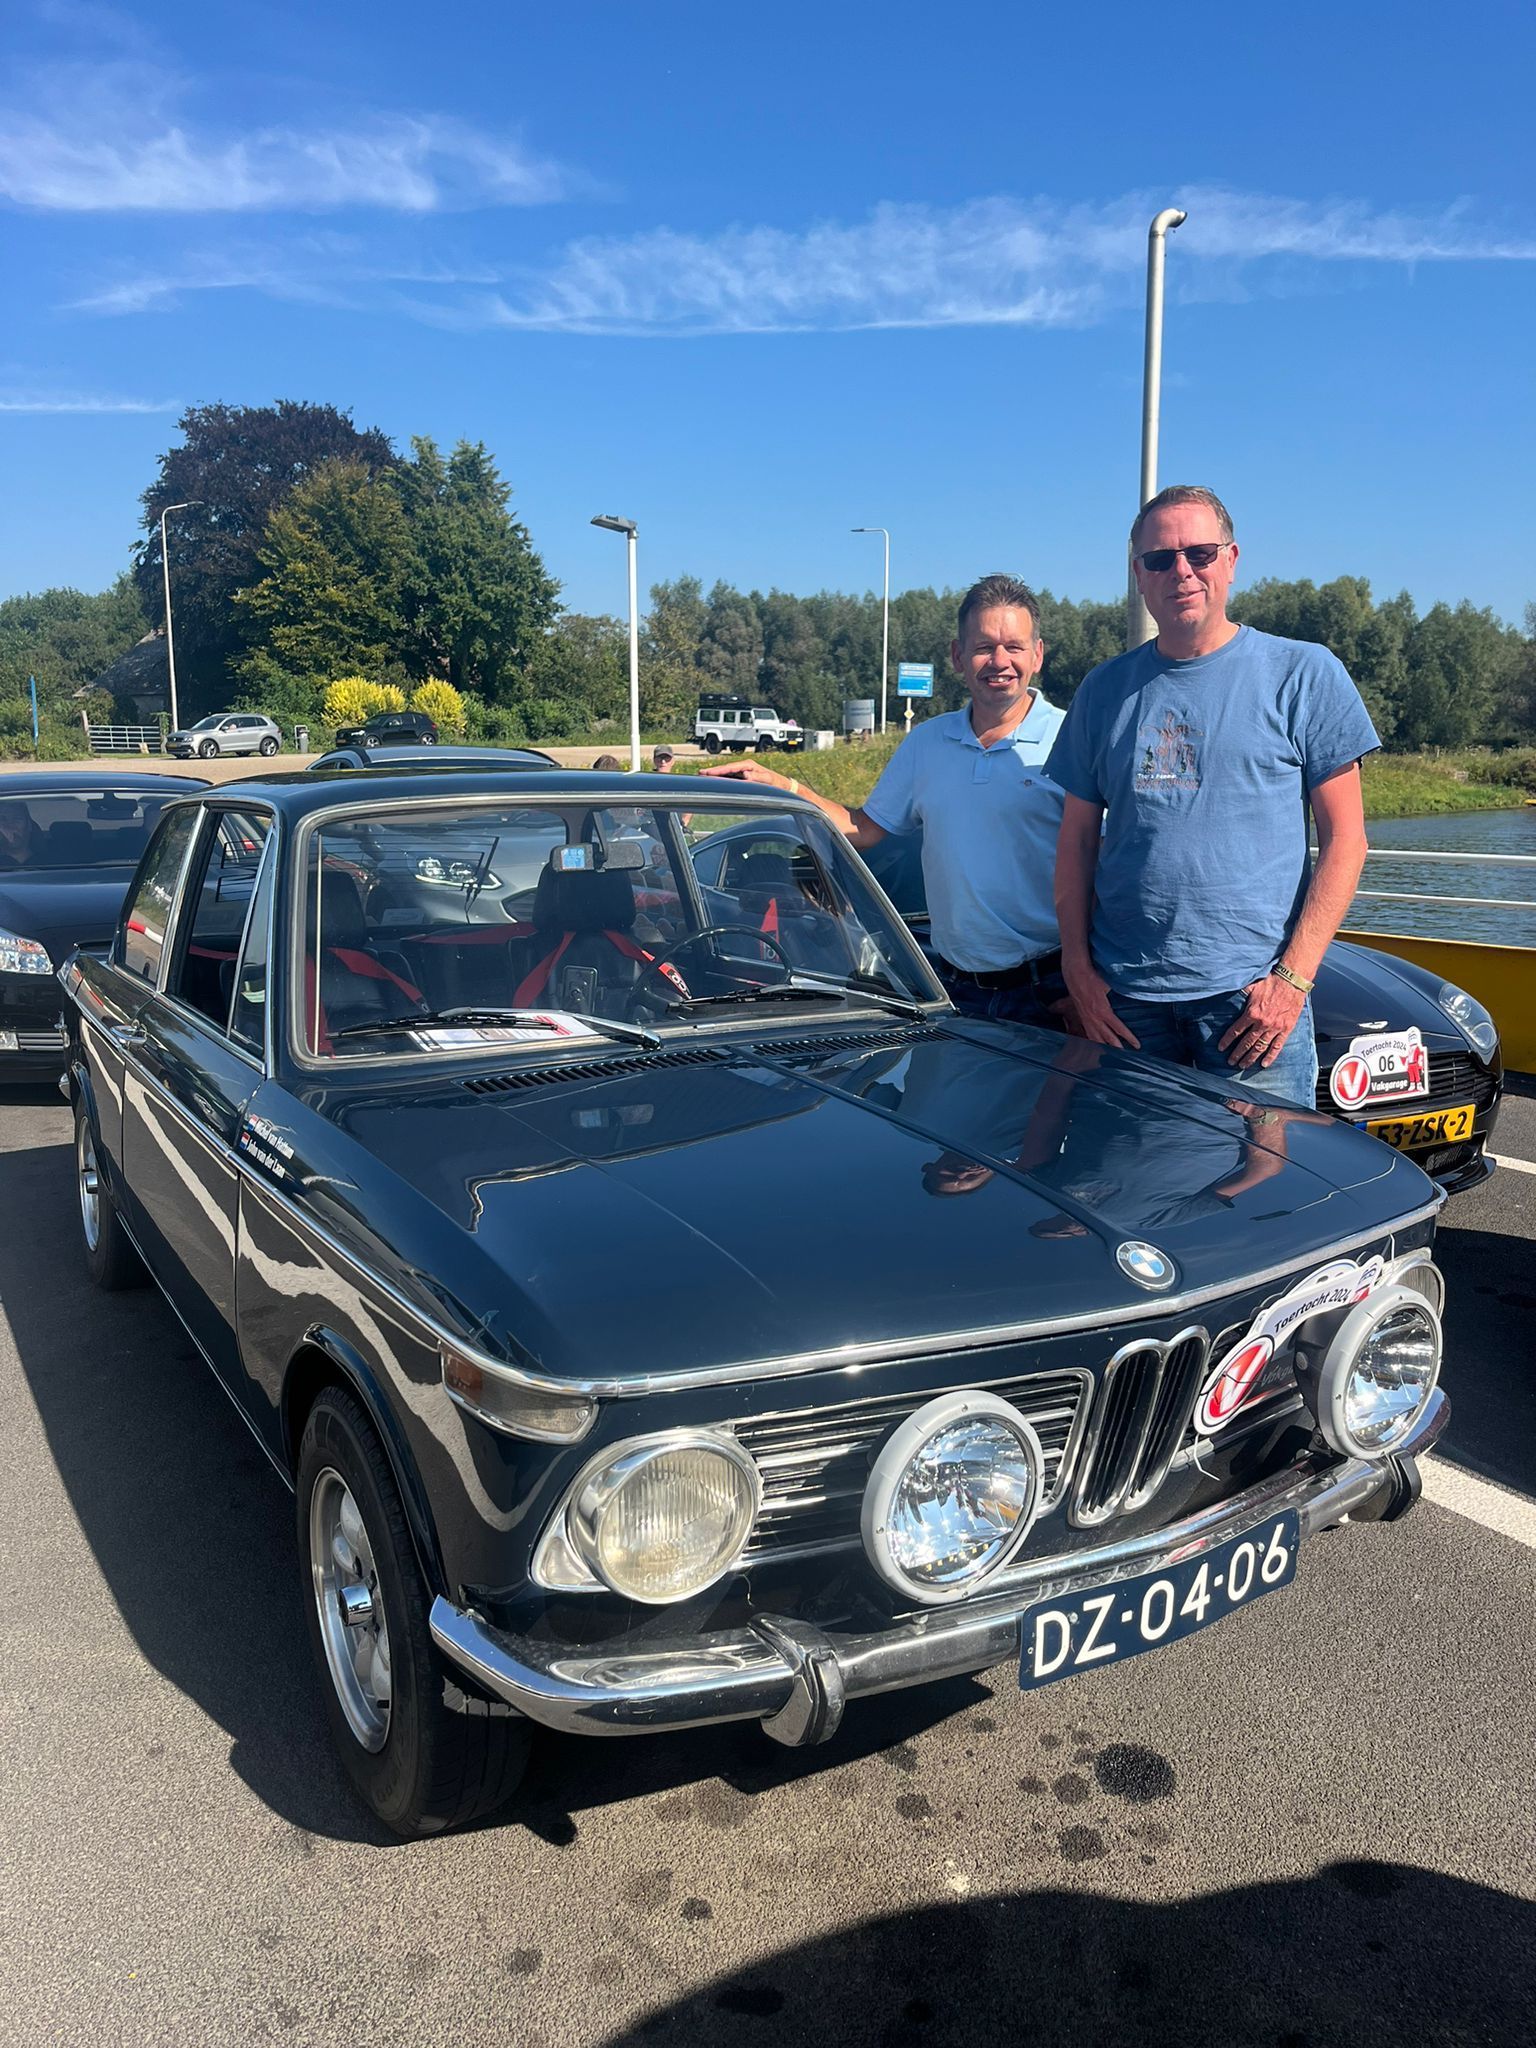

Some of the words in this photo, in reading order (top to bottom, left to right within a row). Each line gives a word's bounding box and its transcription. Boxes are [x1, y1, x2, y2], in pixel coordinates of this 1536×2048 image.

[1361, 1040, 1392, 1057] Toertocht
[1393, 1040, 1408, 1051] 2024
[1379, 1055, 1395, 1072] 06
[1371, 1079, 1408, 1092] Vakgarage
[1377, 1111, 1468, 1147] 53-ZSK-2
[1274, 1292, 1330, 1333] Toertocht
[1328, 1288, 1352, 1304] 2024
